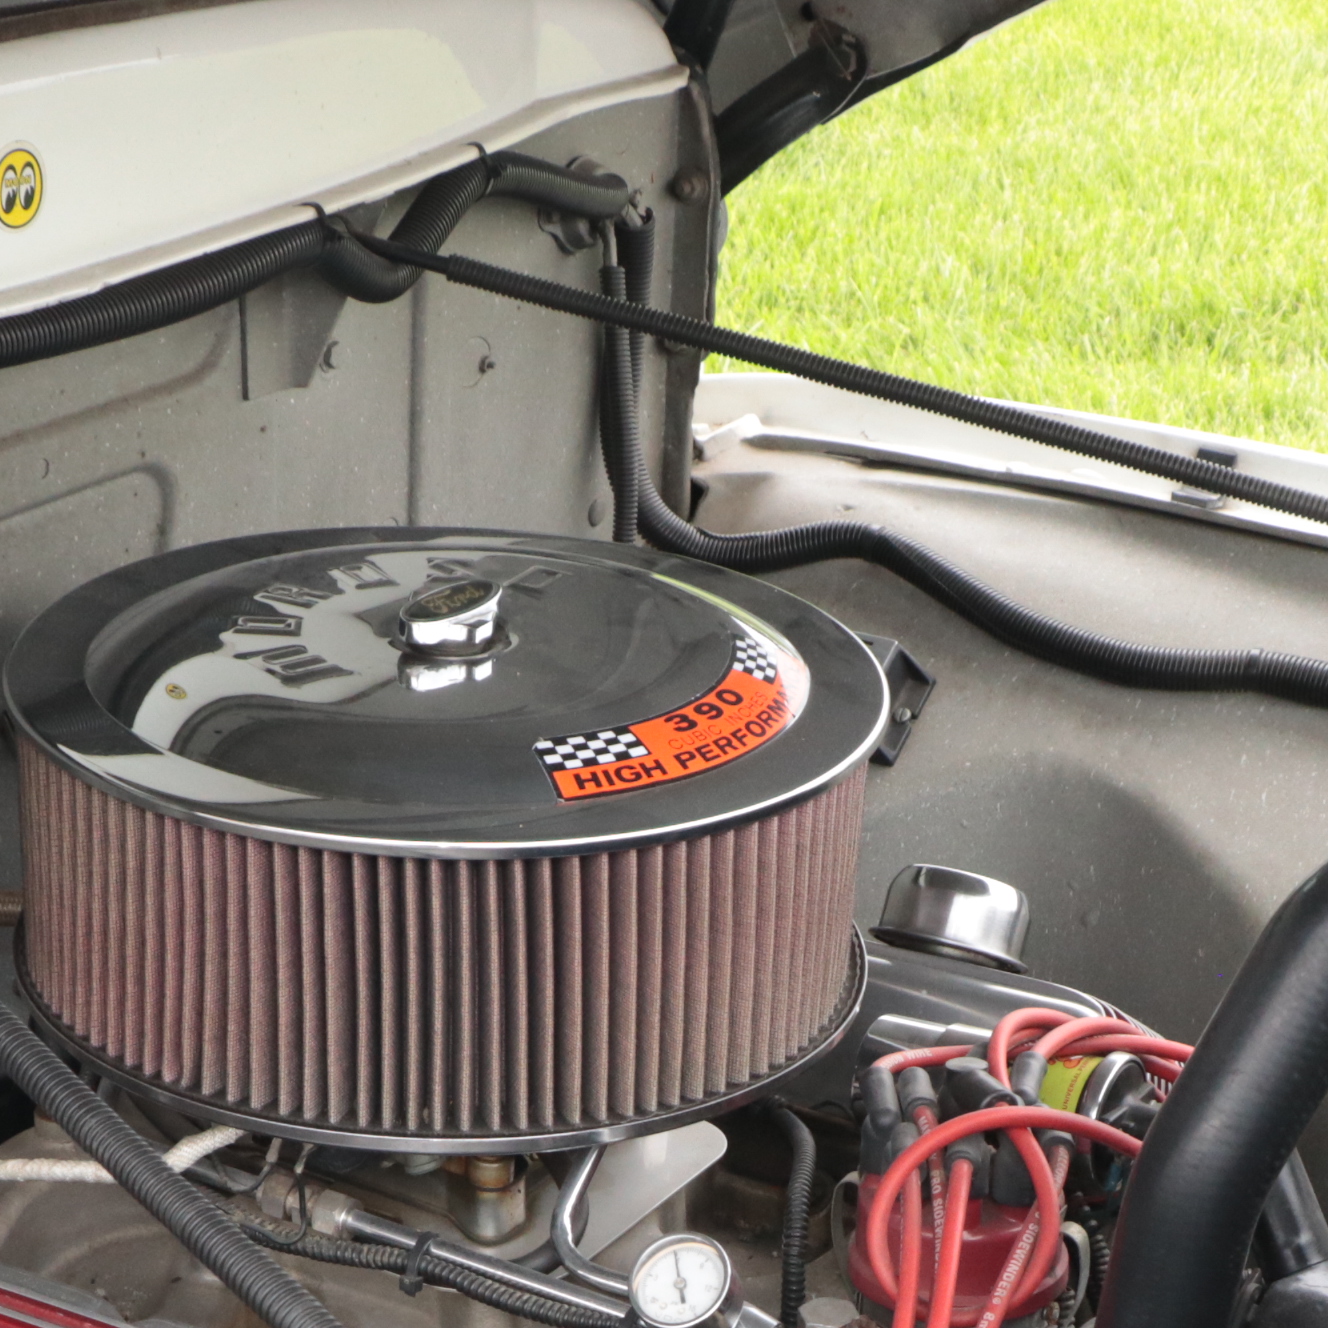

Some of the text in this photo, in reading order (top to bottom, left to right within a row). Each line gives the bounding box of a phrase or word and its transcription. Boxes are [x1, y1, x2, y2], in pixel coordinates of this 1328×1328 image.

[4, 174, 32, 188] MOON
[421, 585, 485, 613] Ford
[663, 688, 744, 733] 390
[667, 691, 769, 752] CUBIC INCHES
[573, 758, 669, 791] HIGH
[1061, 1070, 1083, 1111] UNIVERSAL
